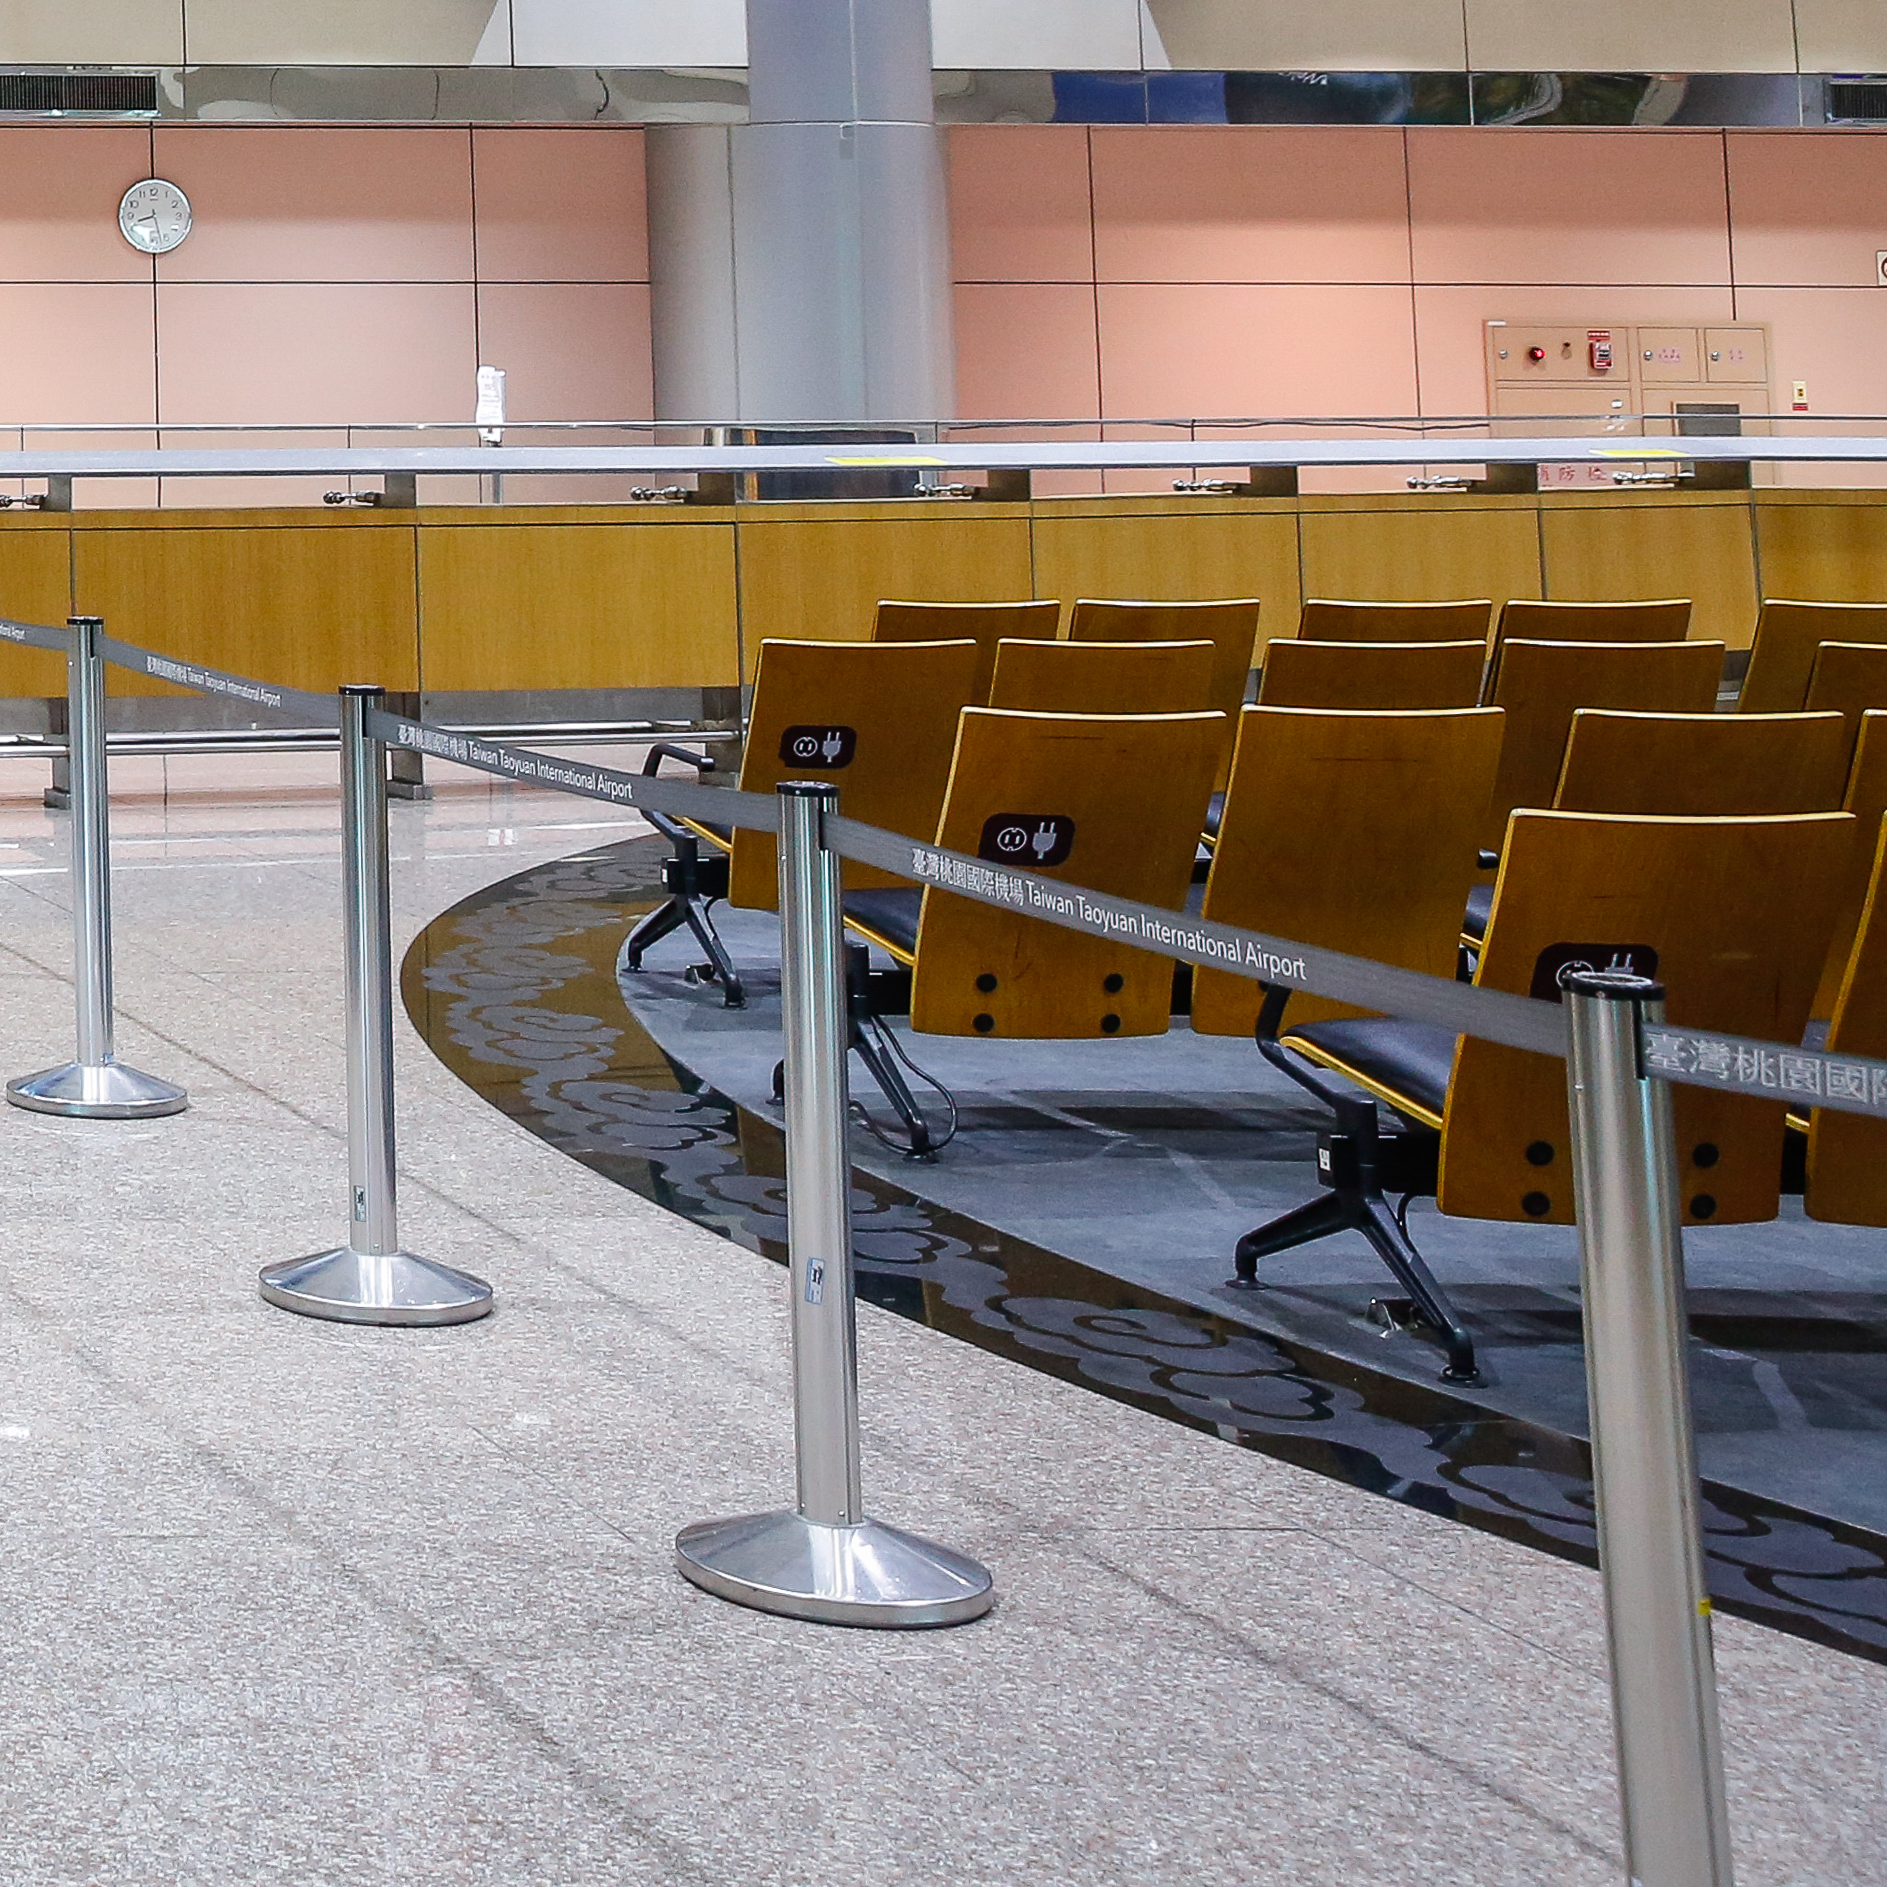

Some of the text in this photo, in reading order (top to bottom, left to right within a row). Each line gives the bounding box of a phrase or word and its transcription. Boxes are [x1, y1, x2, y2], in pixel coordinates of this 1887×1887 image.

[469, 740, 498, 765] Taiwan
[499, 748, 536, 777] Taoyuan
[537, 759, 596, 790] International
[597, 774, 633, 800] Airport
[1026, 881, 1074, 917] Taiwan
[1076, 895, 1138, 935] Taoyuan
[1141, 914, 1241, 962] International
[1245, 941, 1307, 980] Airport
